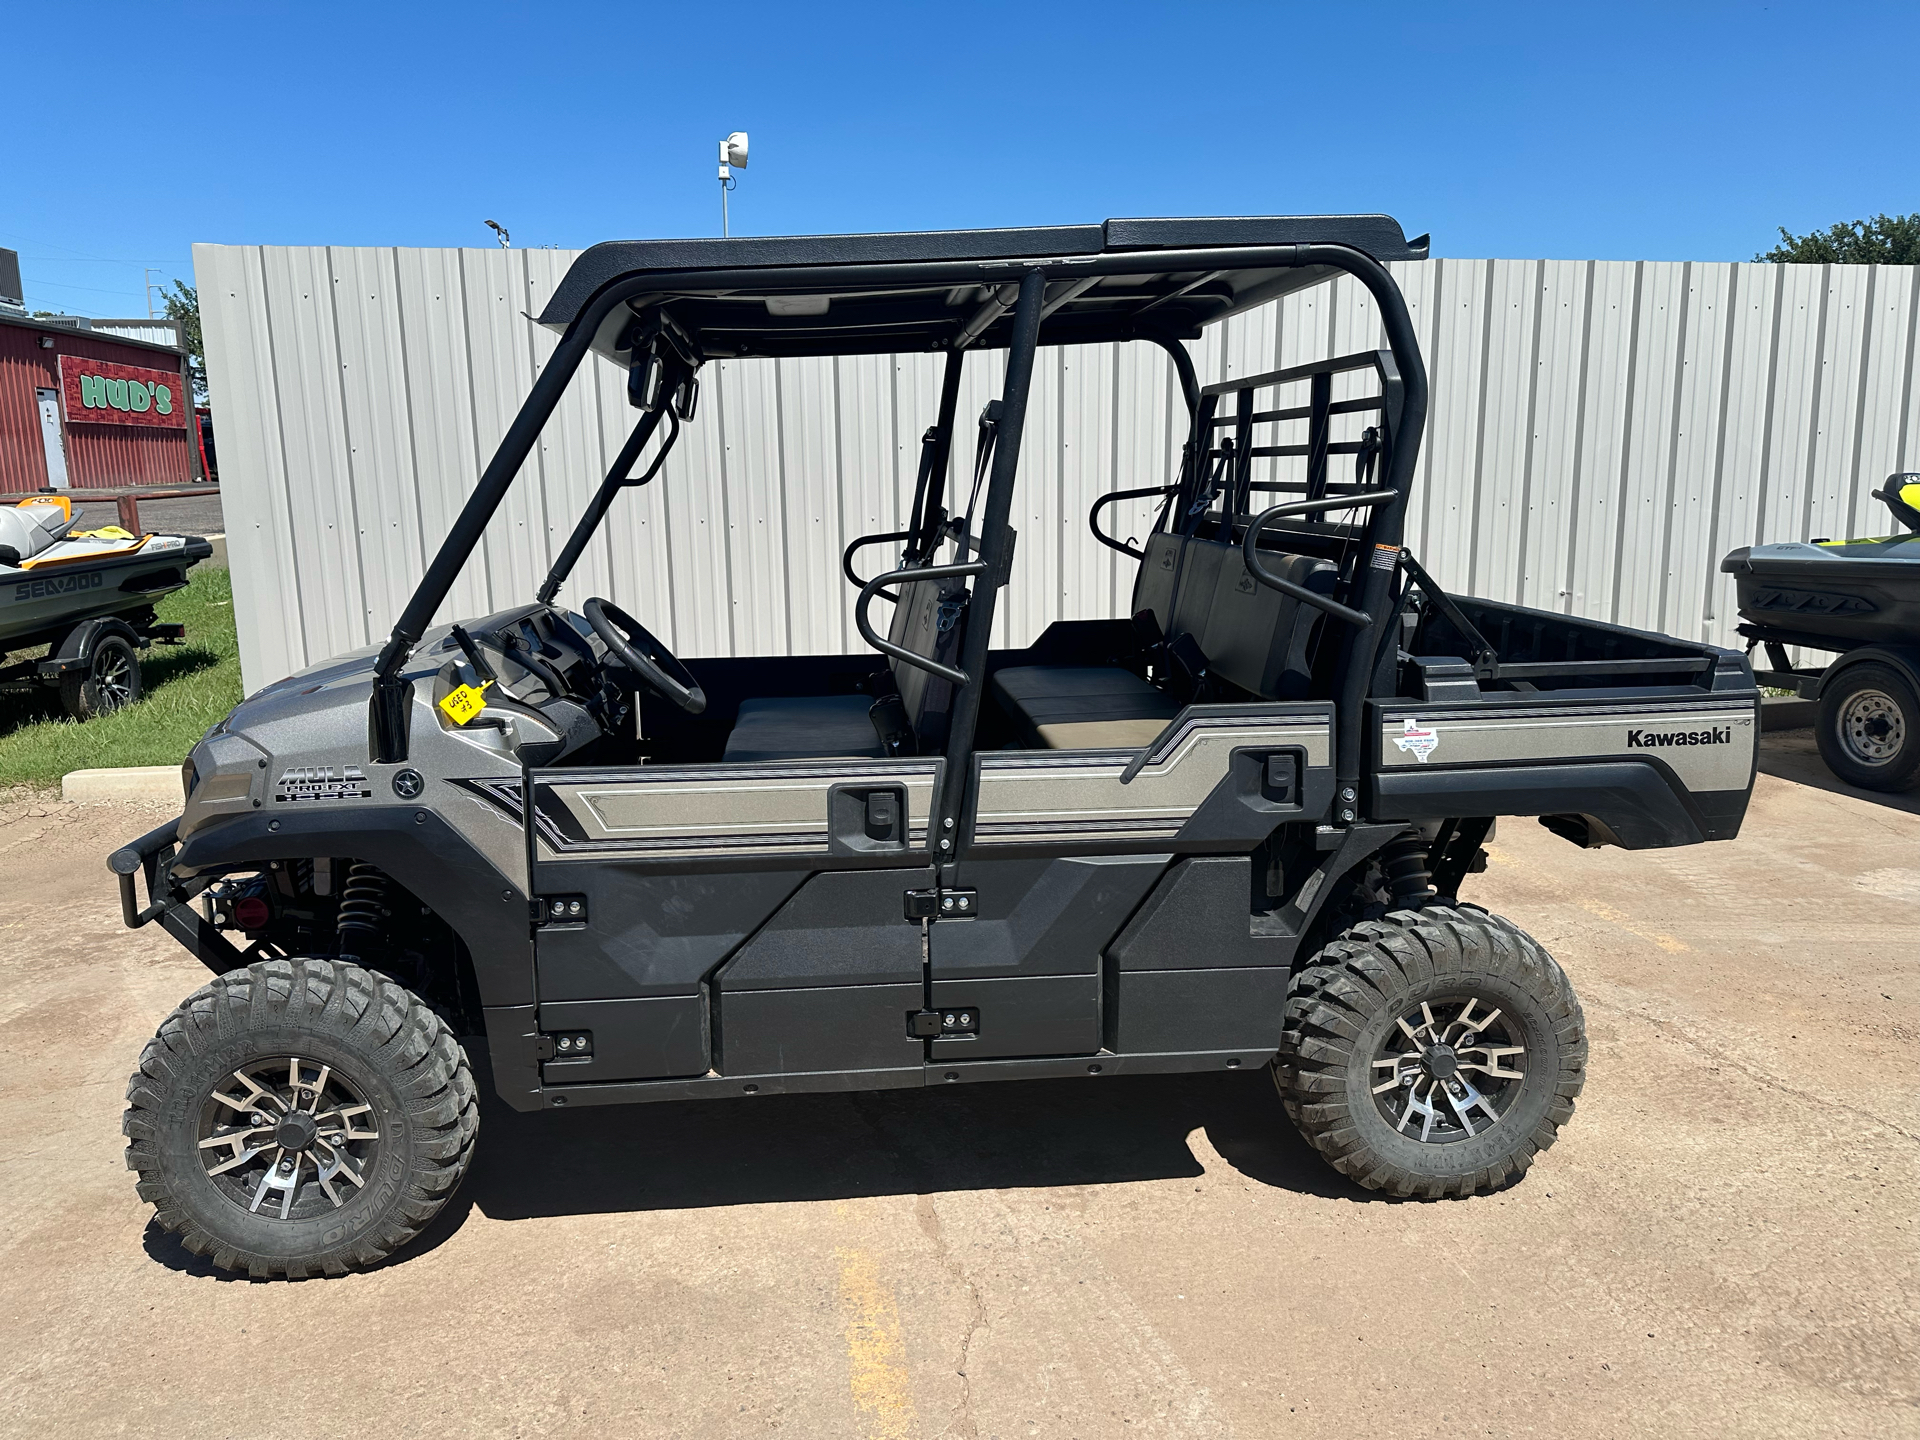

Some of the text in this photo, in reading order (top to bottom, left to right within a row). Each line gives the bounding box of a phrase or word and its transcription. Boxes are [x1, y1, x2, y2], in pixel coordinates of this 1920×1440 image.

[80, 374, 173, 416] HUD'S
[448, 690, 468, 709] USED
[1627, 726, 1731, 748] Kawasaki
[276, 764, 368, 785] MULE
[321, 1152, 406, 1248] DURO
